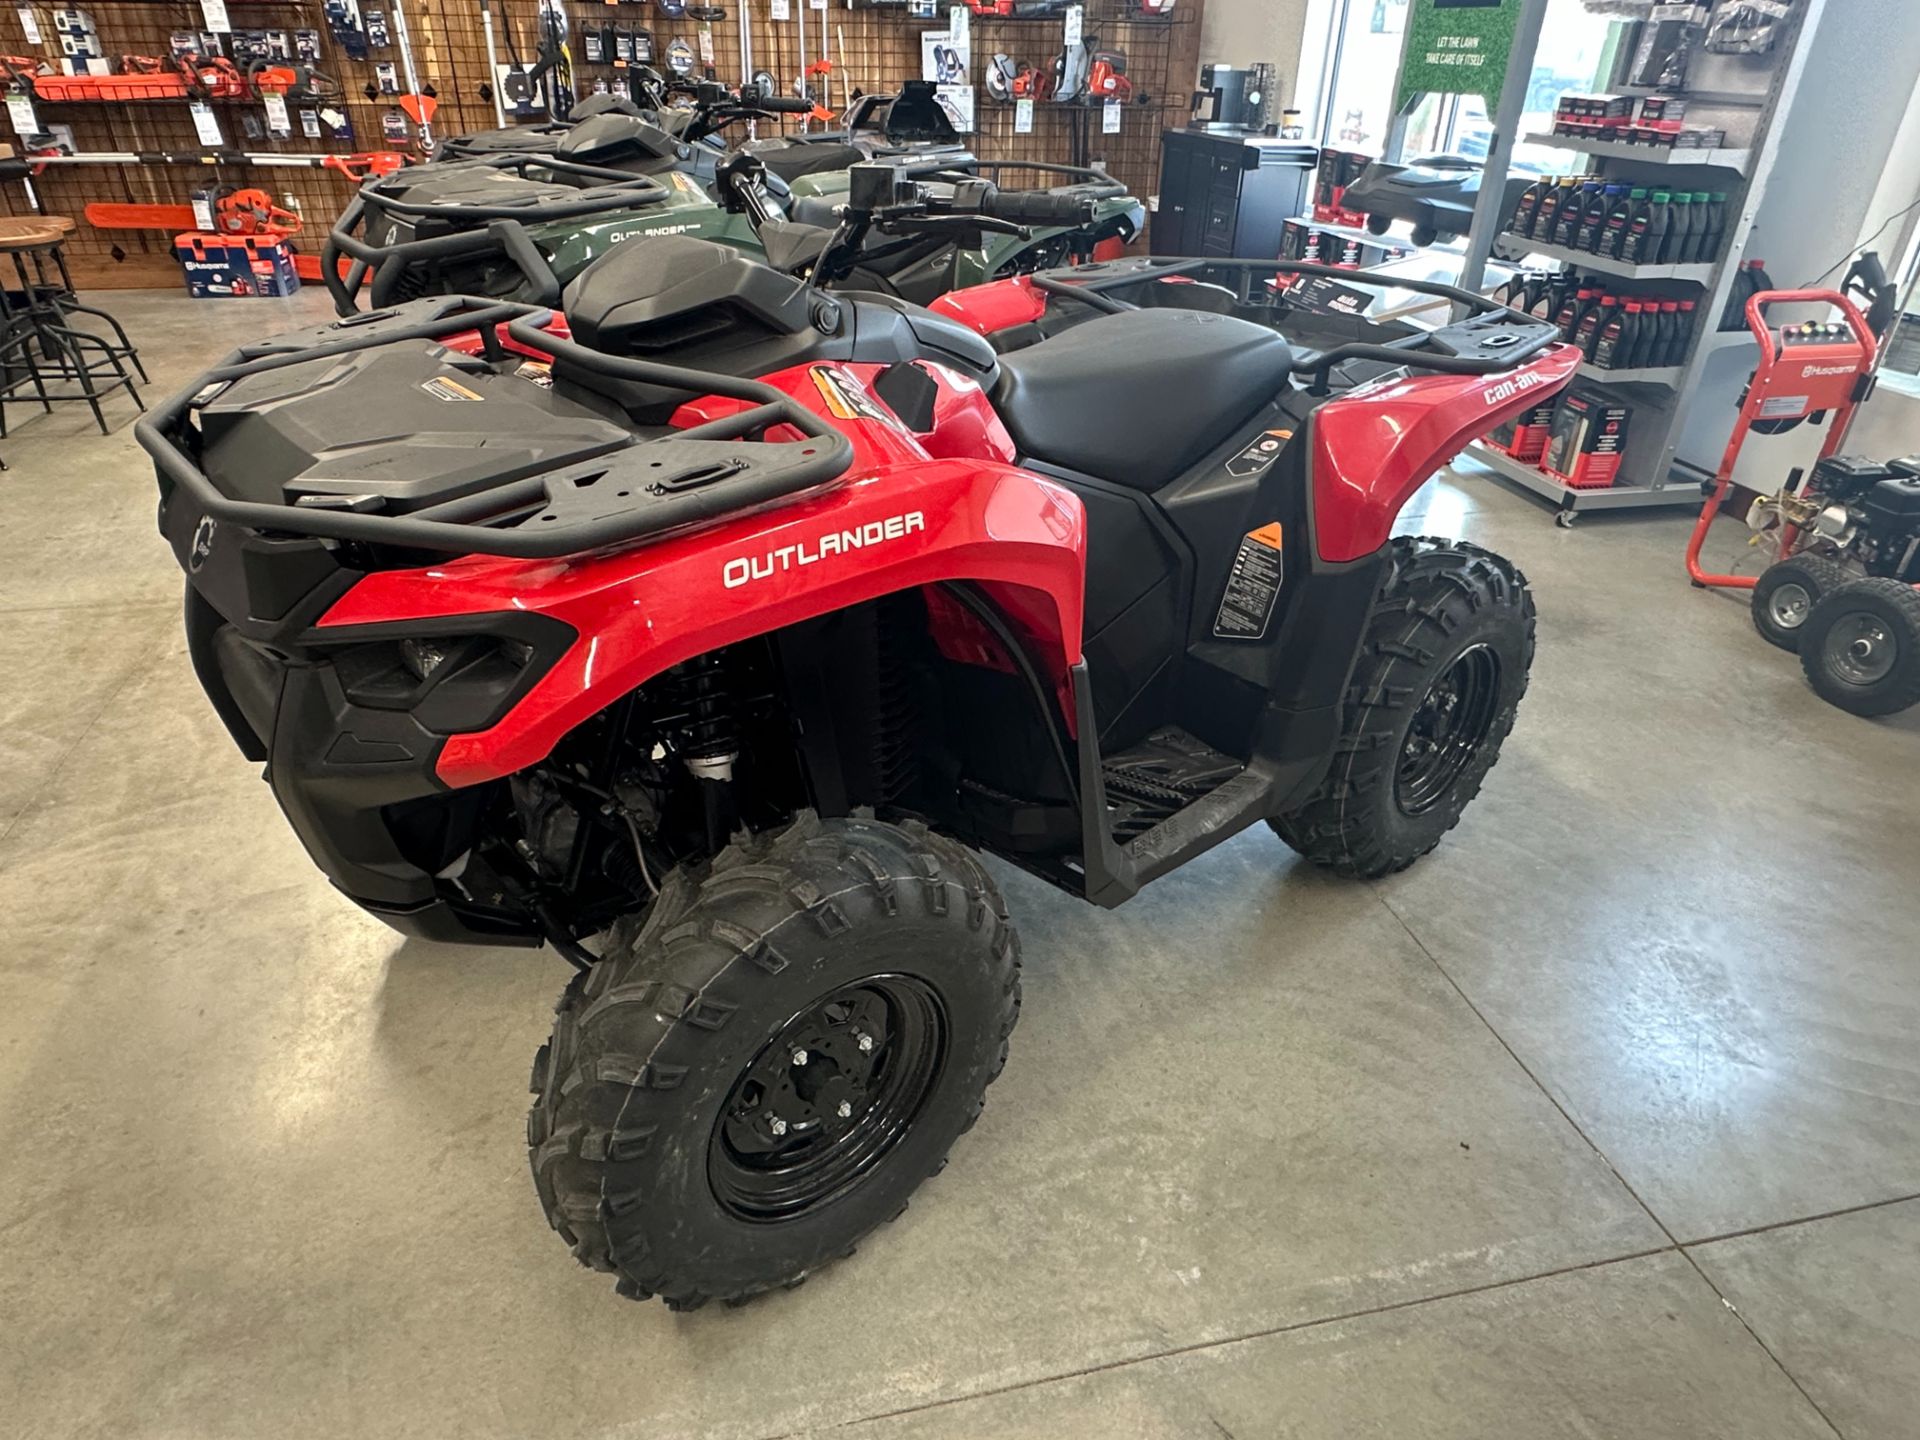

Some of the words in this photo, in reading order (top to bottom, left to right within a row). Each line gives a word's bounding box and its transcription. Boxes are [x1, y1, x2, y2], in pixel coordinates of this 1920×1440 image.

[1437, 36, 1448, 48] LET
[1448, 36, 1460, 48] THE
[1460, 36, 1480, 49] LAWN
[1425, 52, 1440, 64] TAKE
[1440, 53, 1457, 65] CARE
[1456, 53, 1466, 66] OF
[1464, 54, 1486, 67] ITSELF
[723, 511, 925, 589] OUTLANDER
